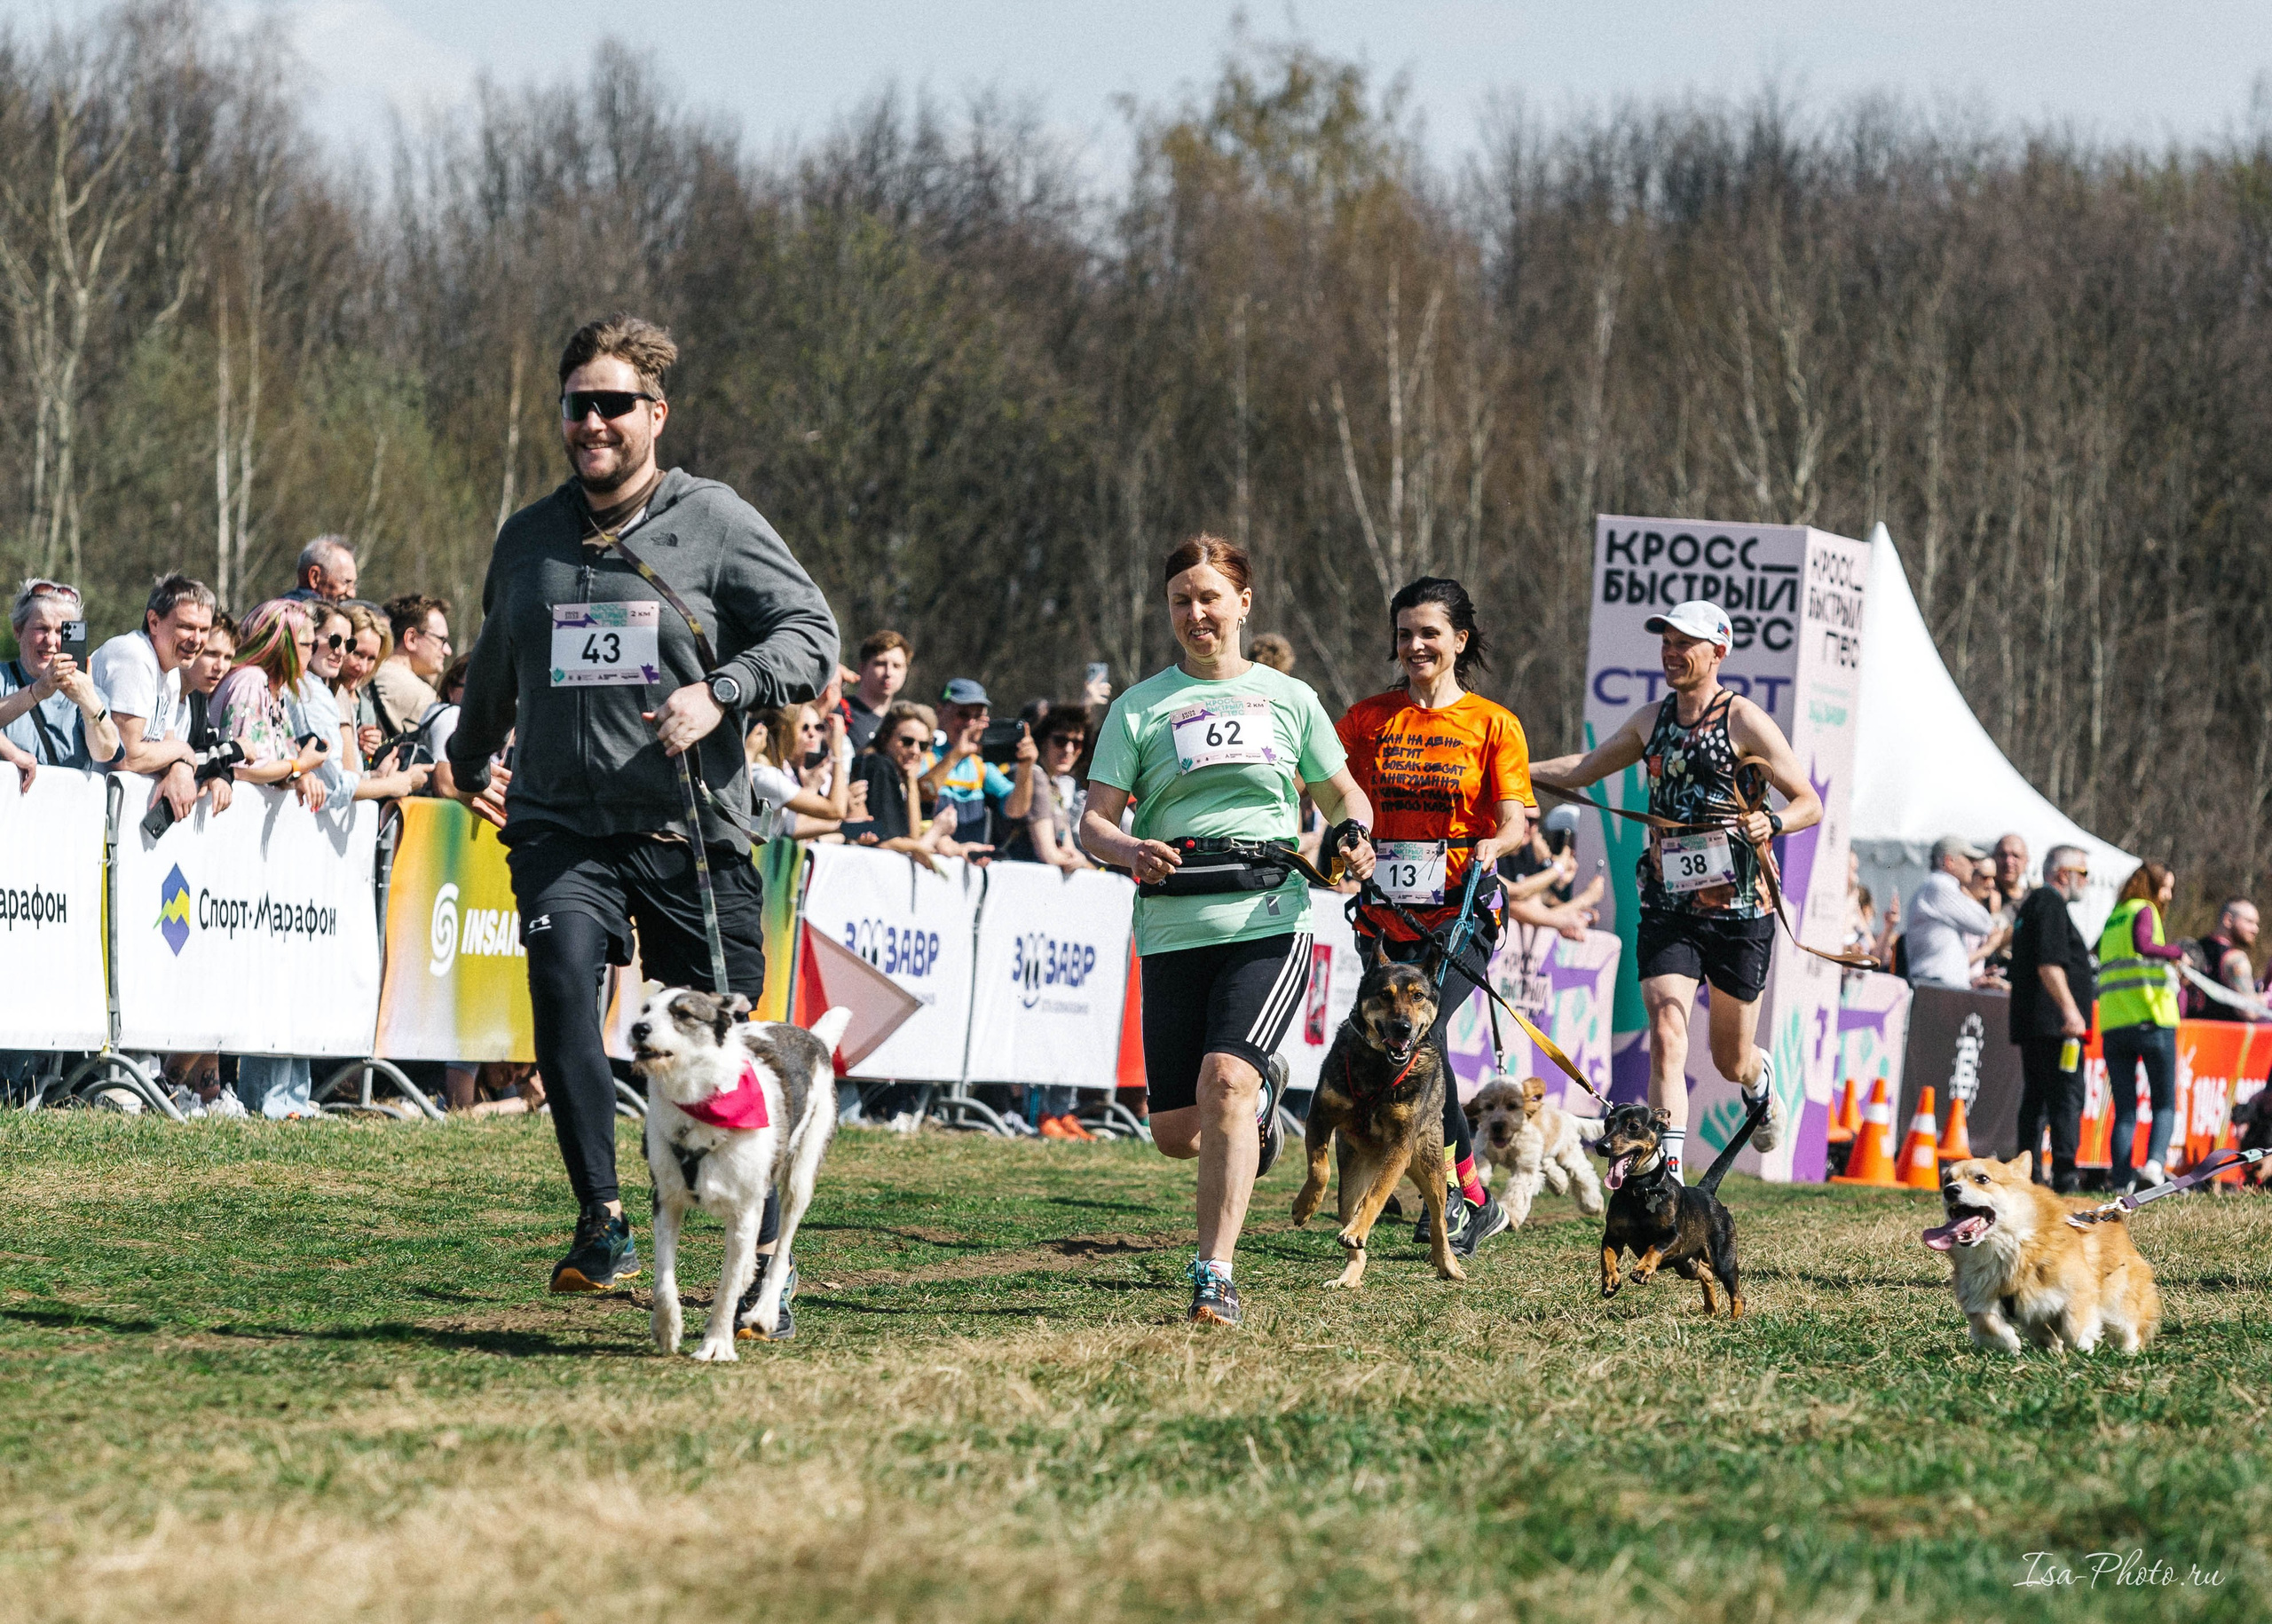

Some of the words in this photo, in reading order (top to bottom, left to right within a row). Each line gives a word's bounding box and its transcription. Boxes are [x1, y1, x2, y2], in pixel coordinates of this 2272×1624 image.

[1603, 568, 1798, 613] БЫСТРЫЙ
[581, 633, 620, 664] 43
[1593, 667, 1792, 713] СТРТ
[1206, 720, 1243, 747] 62
[1407, 734, 1423, 745] НА
[1424, 736, 1464, 749] ДЕНЬ:
[1383, 746, 1424, 759] БЕГИТ
[1382, 759, 1422, 772] СОБАК
[1389, 864, 1416, 887] 13
[1680, 854, 1708, 877] 38
